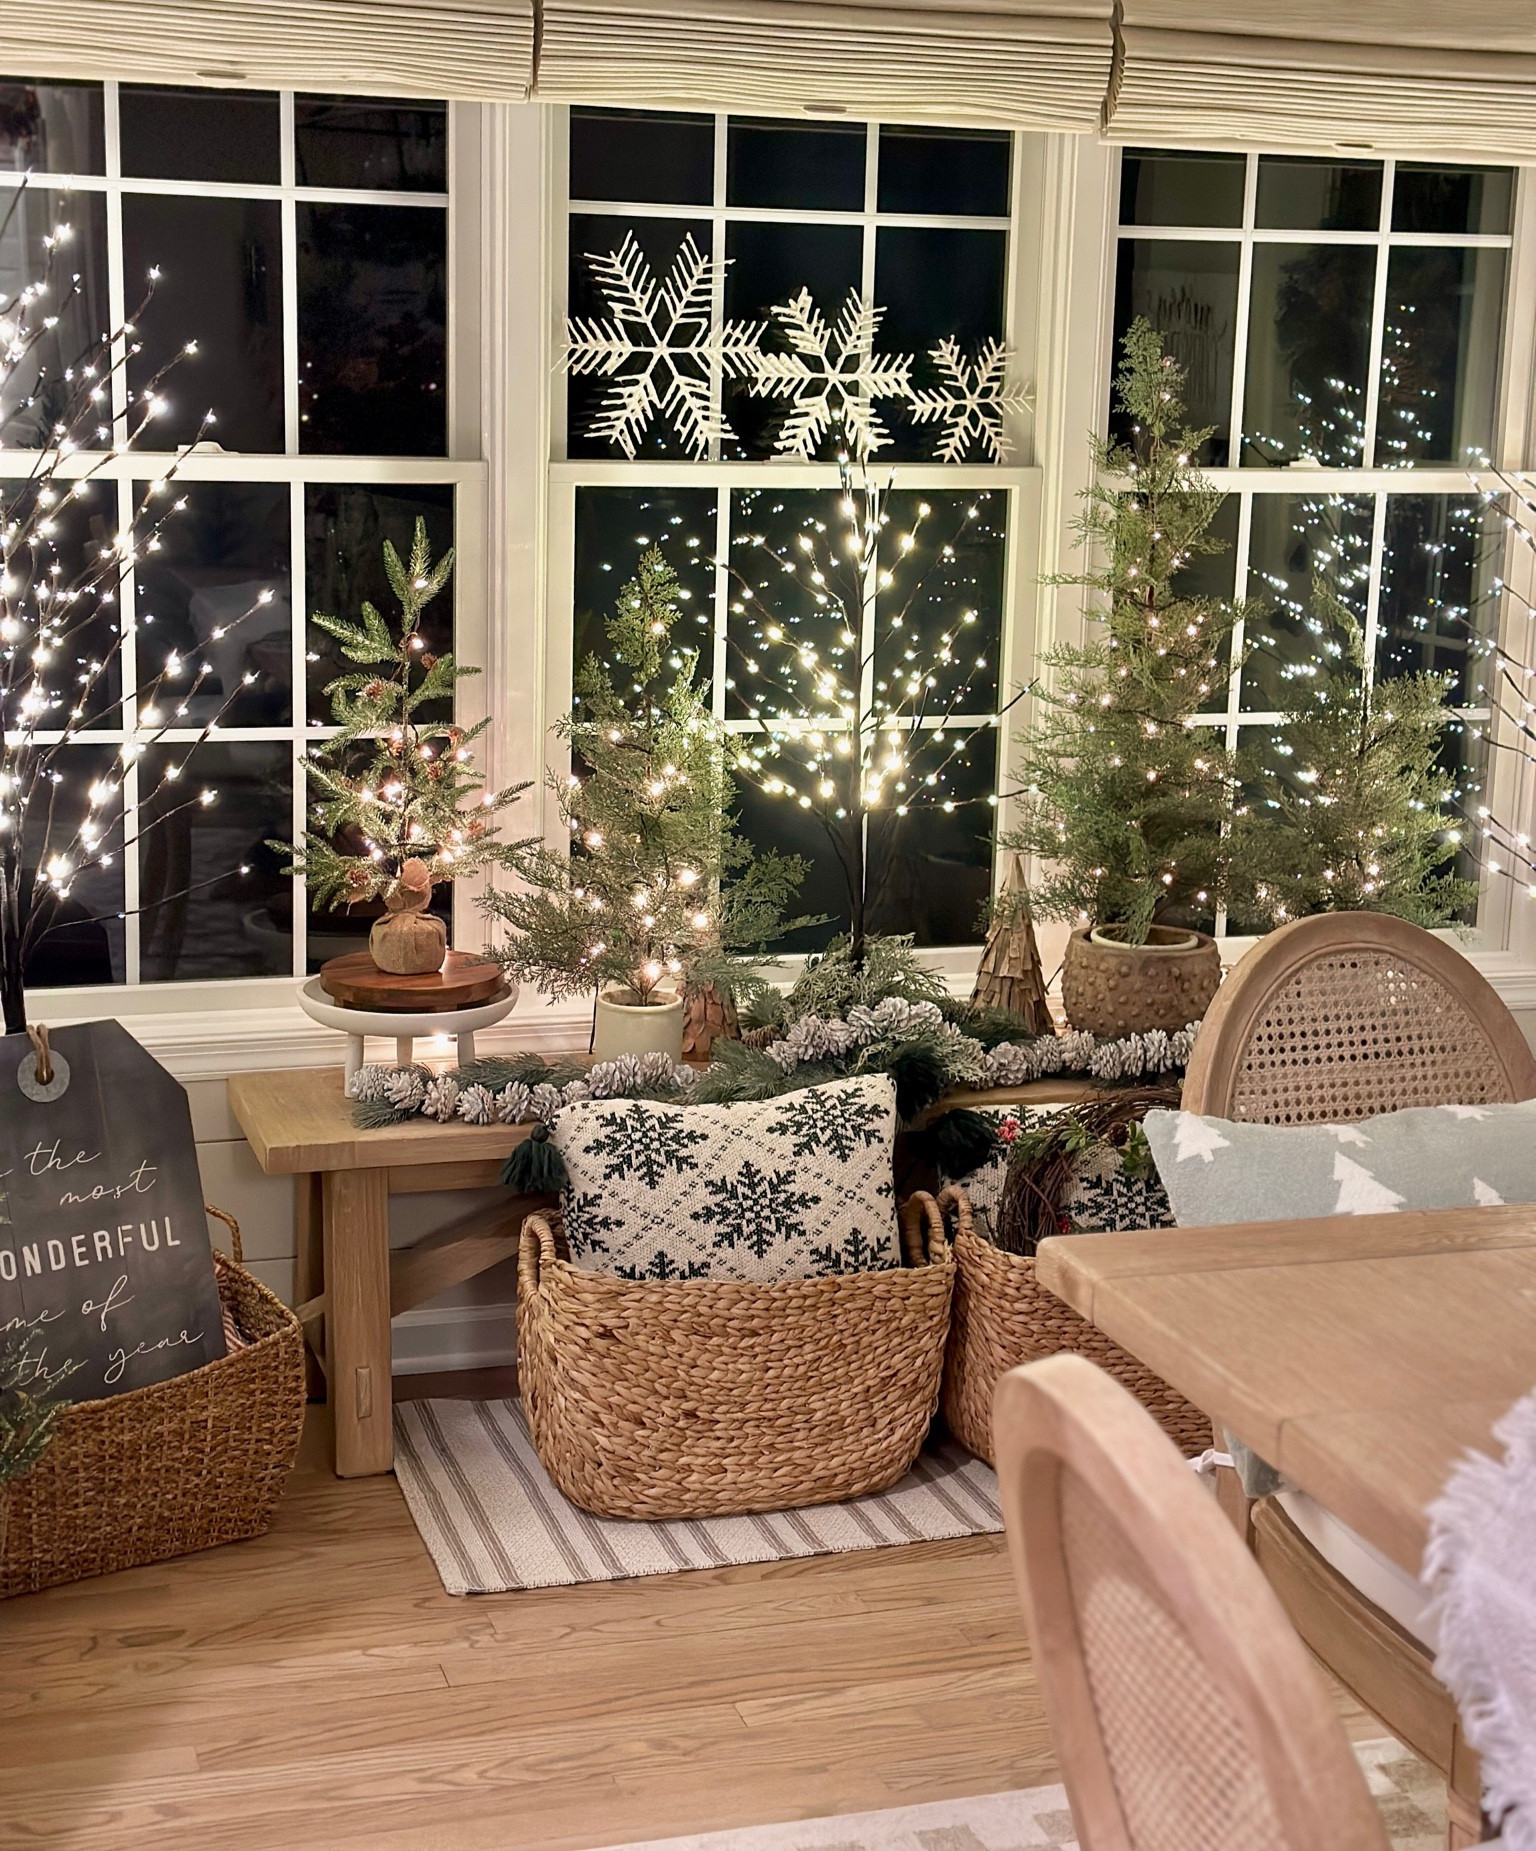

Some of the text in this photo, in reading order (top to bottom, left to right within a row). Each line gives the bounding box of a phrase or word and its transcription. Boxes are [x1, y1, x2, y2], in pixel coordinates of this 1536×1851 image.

[24, 1138, 102, 1176] the
[59, 1159, 158, 1206] most
[81, 1274, 136, 1332] of
[10, 1328, 205, 1387] the year
